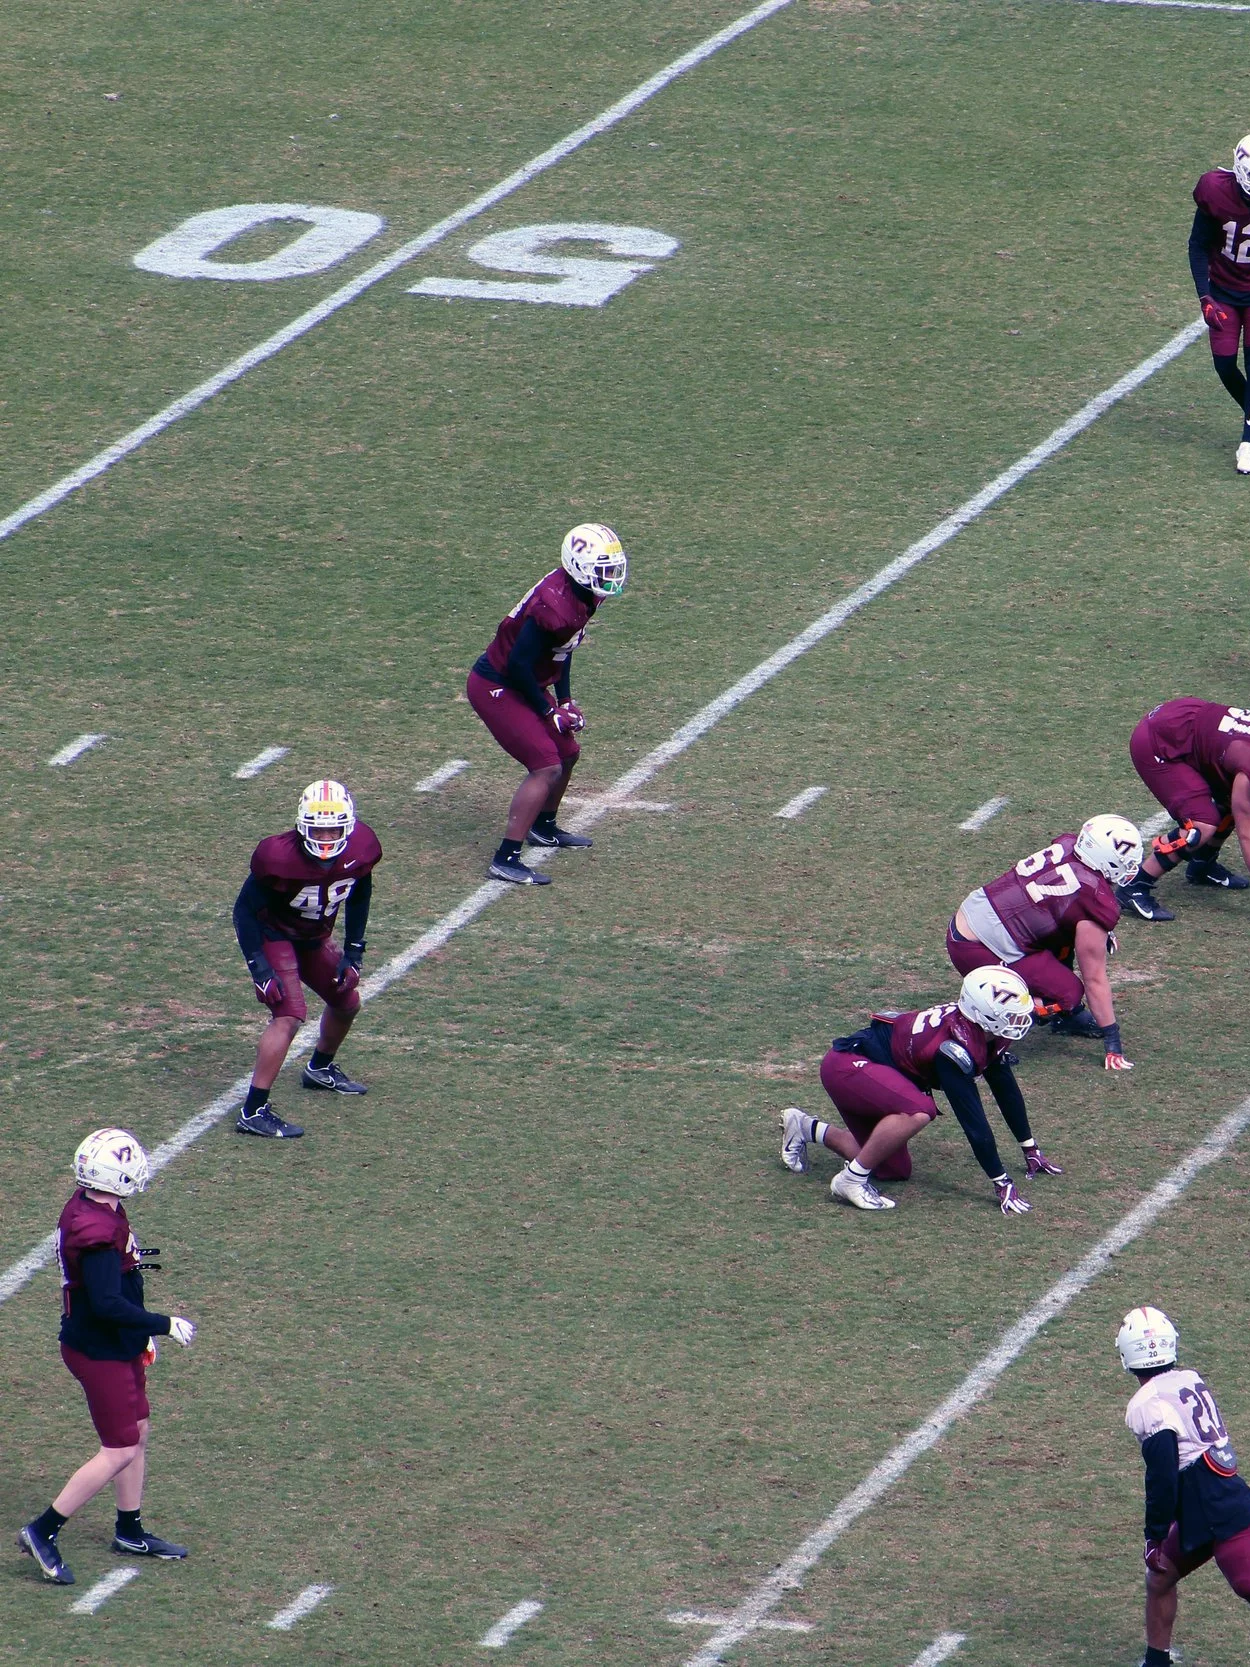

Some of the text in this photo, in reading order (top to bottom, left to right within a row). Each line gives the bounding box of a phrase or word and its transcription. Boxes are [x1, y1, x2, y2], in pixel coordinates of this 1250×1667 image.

[289, 877, 357, 920] 48
[1016, 843, 1082, 904] 67
[1148, 1350, 1158, 1358] 20
[1179, 1382, 1229, 1443] 20
